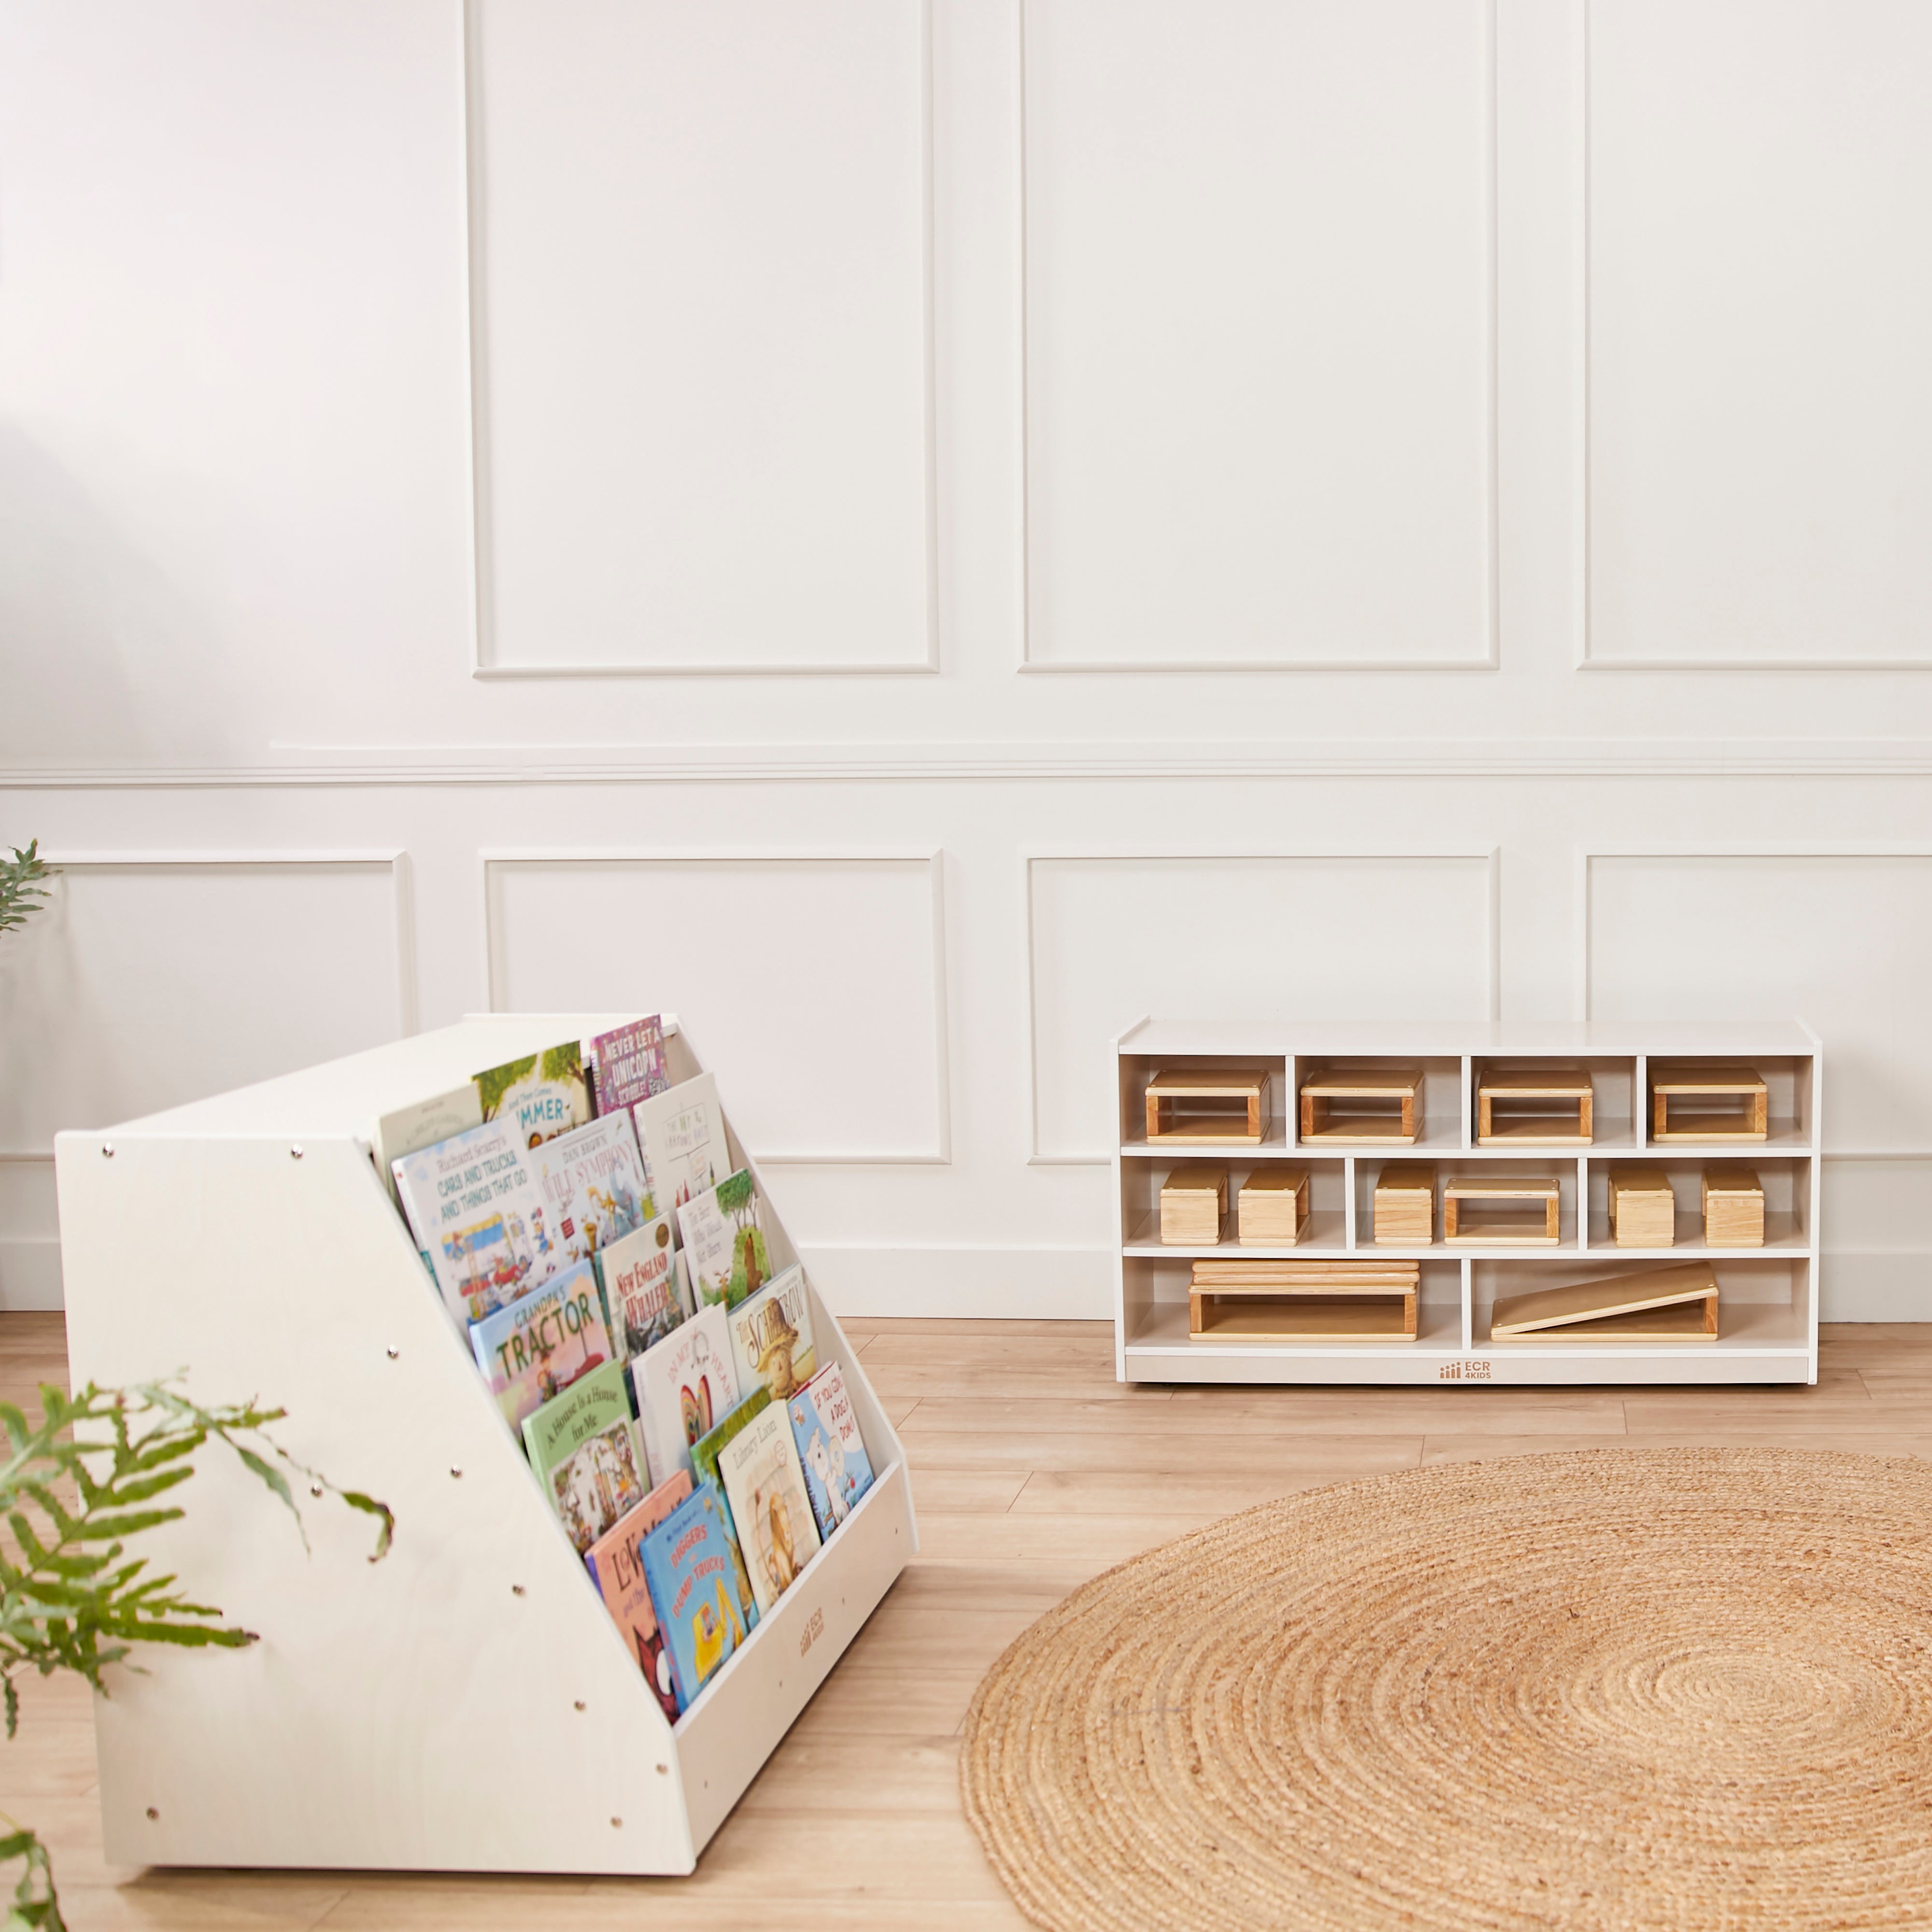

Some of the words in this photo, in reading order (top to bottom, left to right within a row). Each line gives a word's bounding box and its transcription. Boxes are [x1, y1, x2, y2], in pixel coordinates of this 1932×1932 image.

[604, 1034, 635, 1061] NEVER
[635, 1027, 652, 1050] LET
[653, 1026, 661, 1044] A
[611, 1048, 657, 1087] UNICORN
[436, 1148, 473, 1174] Richard
[473, 1136, 507, 1159] Scarry's
[563, 1148, 579, 1164] DAN
[581, 1134, 607, 1156] BROWN
[437, 1174, 463, 1198] CARS
[463, 1165, 482, 1188] AND
[482, 1150, 517, 1178] TRUCKS
[440, 1200, 460, 1225] AND
[459, 1184, 492, 1213] THINGS
[491, 1174, 513, 1197] THAT
[513, 1168, 527, 1186] GO
[616, 1272, 635, 1299] NEW
[634, 1251, 668, 1288] ENGLAND
[514, 1285, 565, 1328] GRANDPA'S
[625, 1281, 668, 1330] WHALER
[496, 1293, 593, 1380] TRACTOR
[1465, 1361, 1491, 1371] ECR
[822, 1384, 832, 1403] YOU
[831, 1409, 836, 1424] A
[834, 1399, 846, 1419] DOG
[547, 1434, 555, 1450] A
[552, 1402, 577, 1437] House
[592, 1386, 618, 1403] House
[571, 1424, 583, 1443] for
[584, 1413, 598, 1433] Me
[839, 1414, 854, 1442] DONUT
[733, 1436, 758, 1470] Library
[757, 1420, 777, 1443] Lion
[670, 1523, 707, 1569] DIGGERS
[671, 1574, 693, 1619] DUMP
[693, 1555, 725, 1582] TRUCKS
